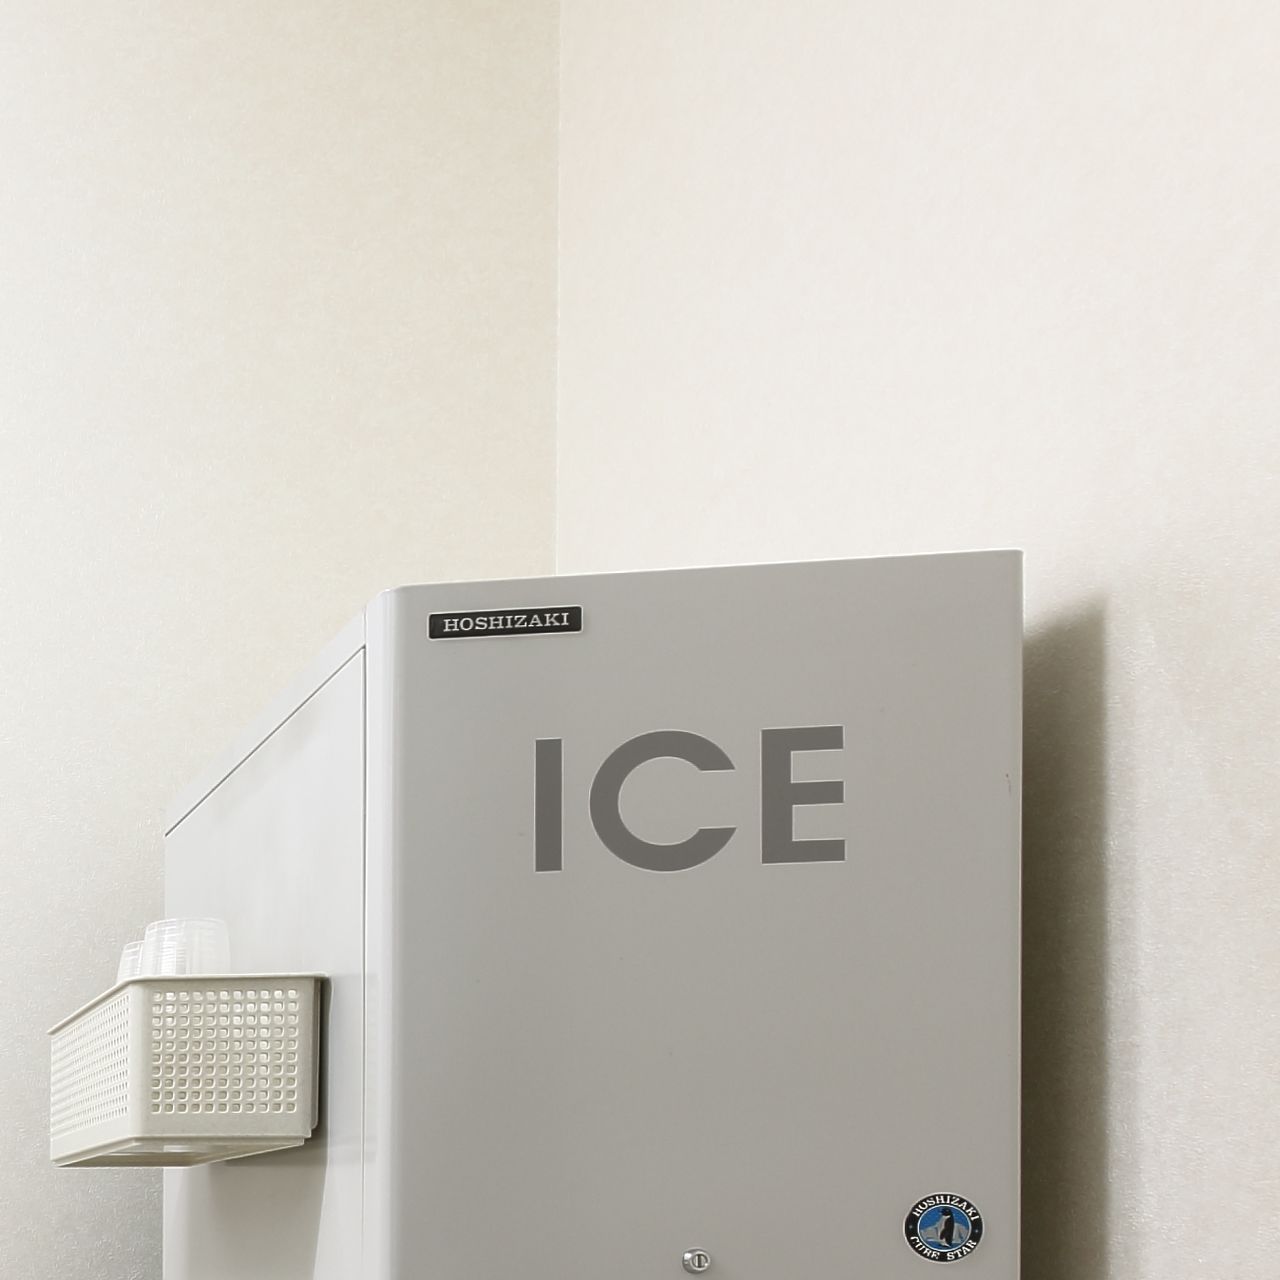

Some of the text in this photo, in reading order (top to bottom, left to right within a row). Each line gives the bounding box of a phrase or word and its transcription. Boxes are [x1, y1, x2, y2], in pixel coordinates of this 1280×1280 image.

[443, 612, 570, 632] HOSHIZAKI
[535, 725, 846, 874] ICE
[912, 1195, 980, 1221] HOSHIZAKI
[946, 1239, 977, 1260] STAR
